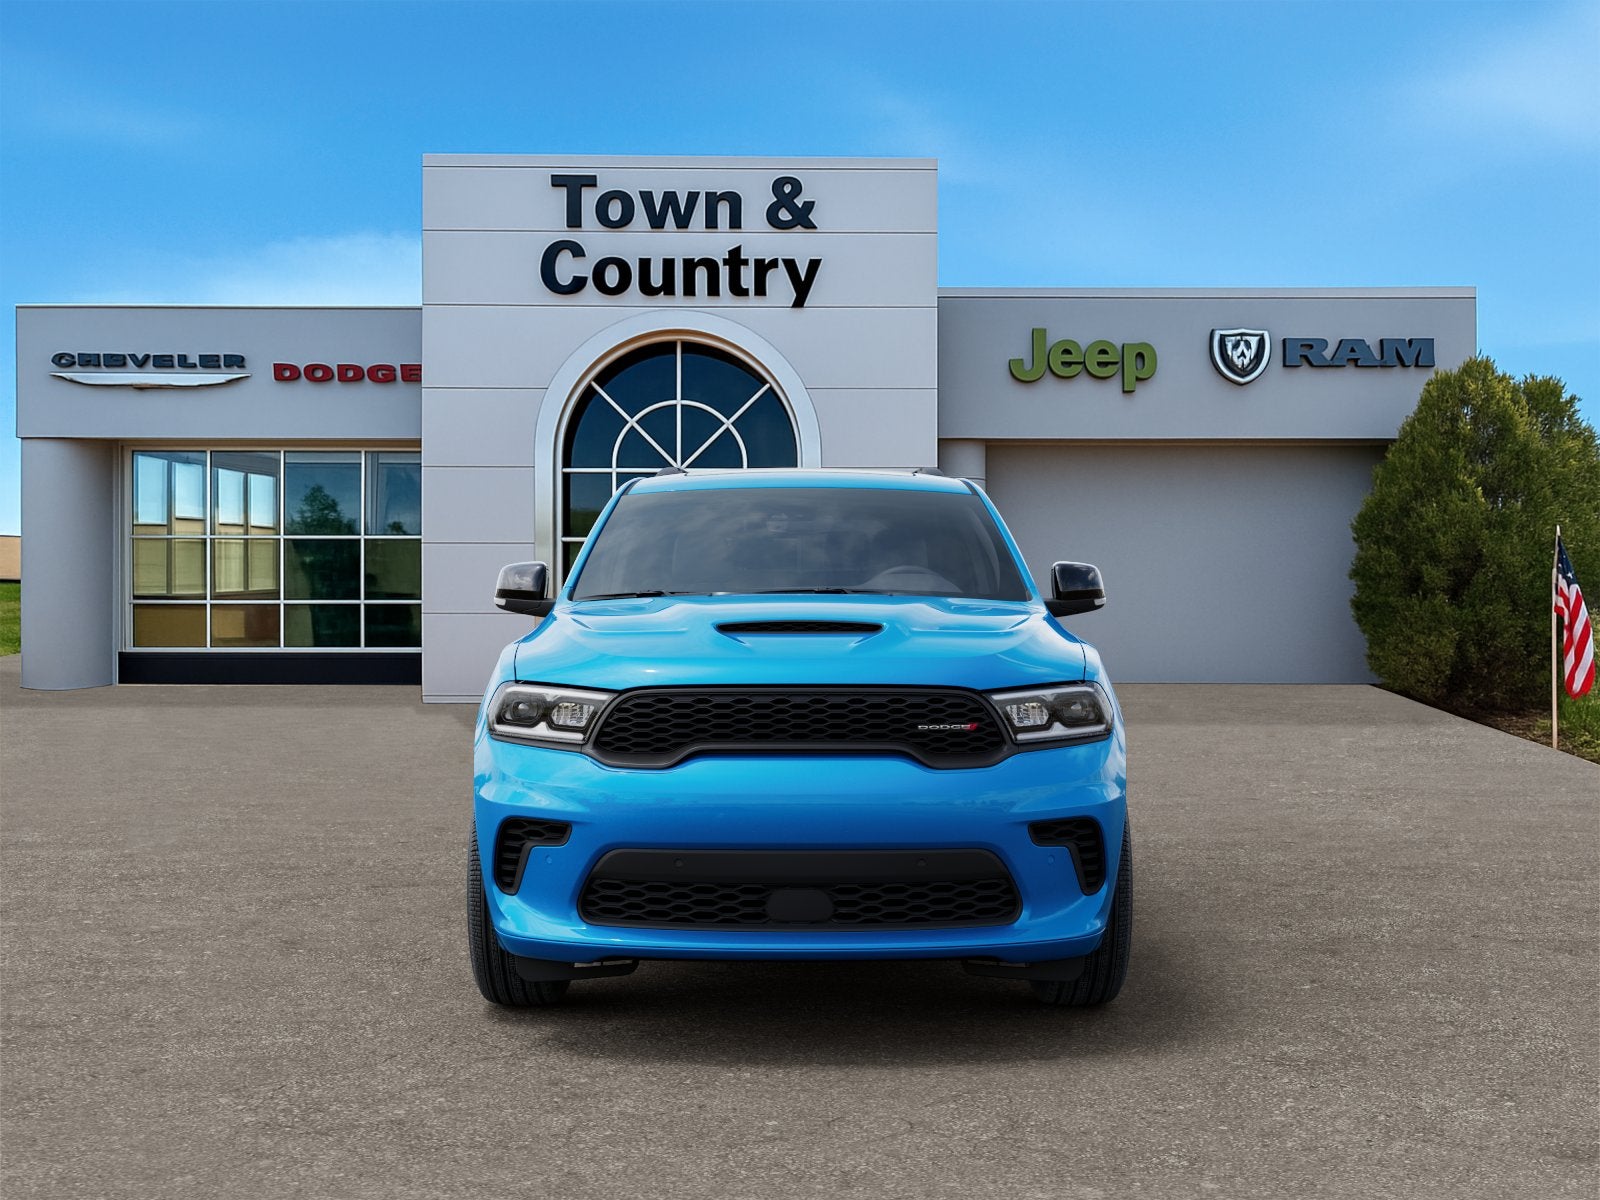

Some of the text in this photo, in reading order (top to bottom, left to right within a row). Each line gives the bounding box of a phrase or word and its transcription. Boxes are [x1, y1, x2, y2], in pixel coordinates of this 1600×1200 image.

[550, 174, 818, 230] Town &
[540, 239, 822, 308] Country
[273, 362, 422, 382] DODGE
[1009, 328, 1157, 392] Jeep
[1282, 337, 1435, 368] RAM
